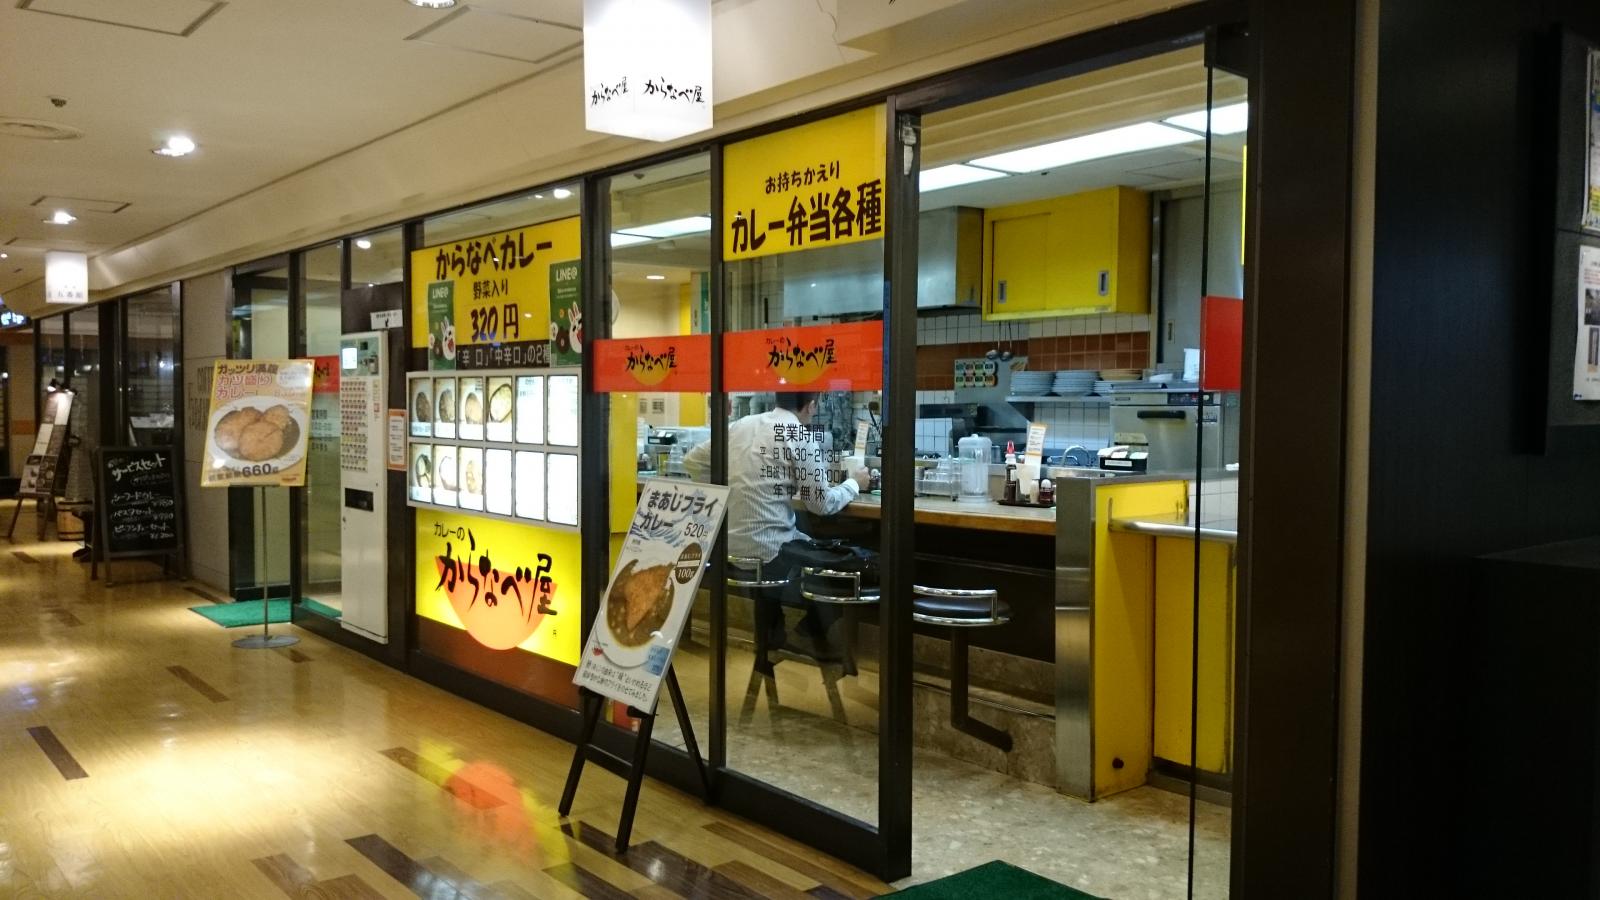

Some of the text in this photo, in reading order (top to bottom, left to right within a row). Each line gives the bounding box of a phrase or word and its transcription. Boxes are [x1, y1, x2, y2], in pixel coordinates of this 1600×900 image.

[591, 75, 629, 107] からなべ屋
[643, 76, 705, 104] からなべ屋
[765, 160, 840, 195] お持ちかえり
[731, 178, 882, 254] カレー弁当各種
[435, 231, 553, 281] からなべカレー
[556, 266, 578, 282] LINE@
[432, 286, 449, 299] LINE@
[473, 279, 509, 300] 野菜入り
[625, 344, 677, 372] からなべ屋
[766, 337, 837, 370] からなべ屋
[773, 423, 825, 443] 営業時間
[773, 483, 826, 502] 年中無休
[434, 521, 465, 541] カレーの
[640, 511, 674, 530] カレー
[435, 528, 557, 624] からなべ屋
